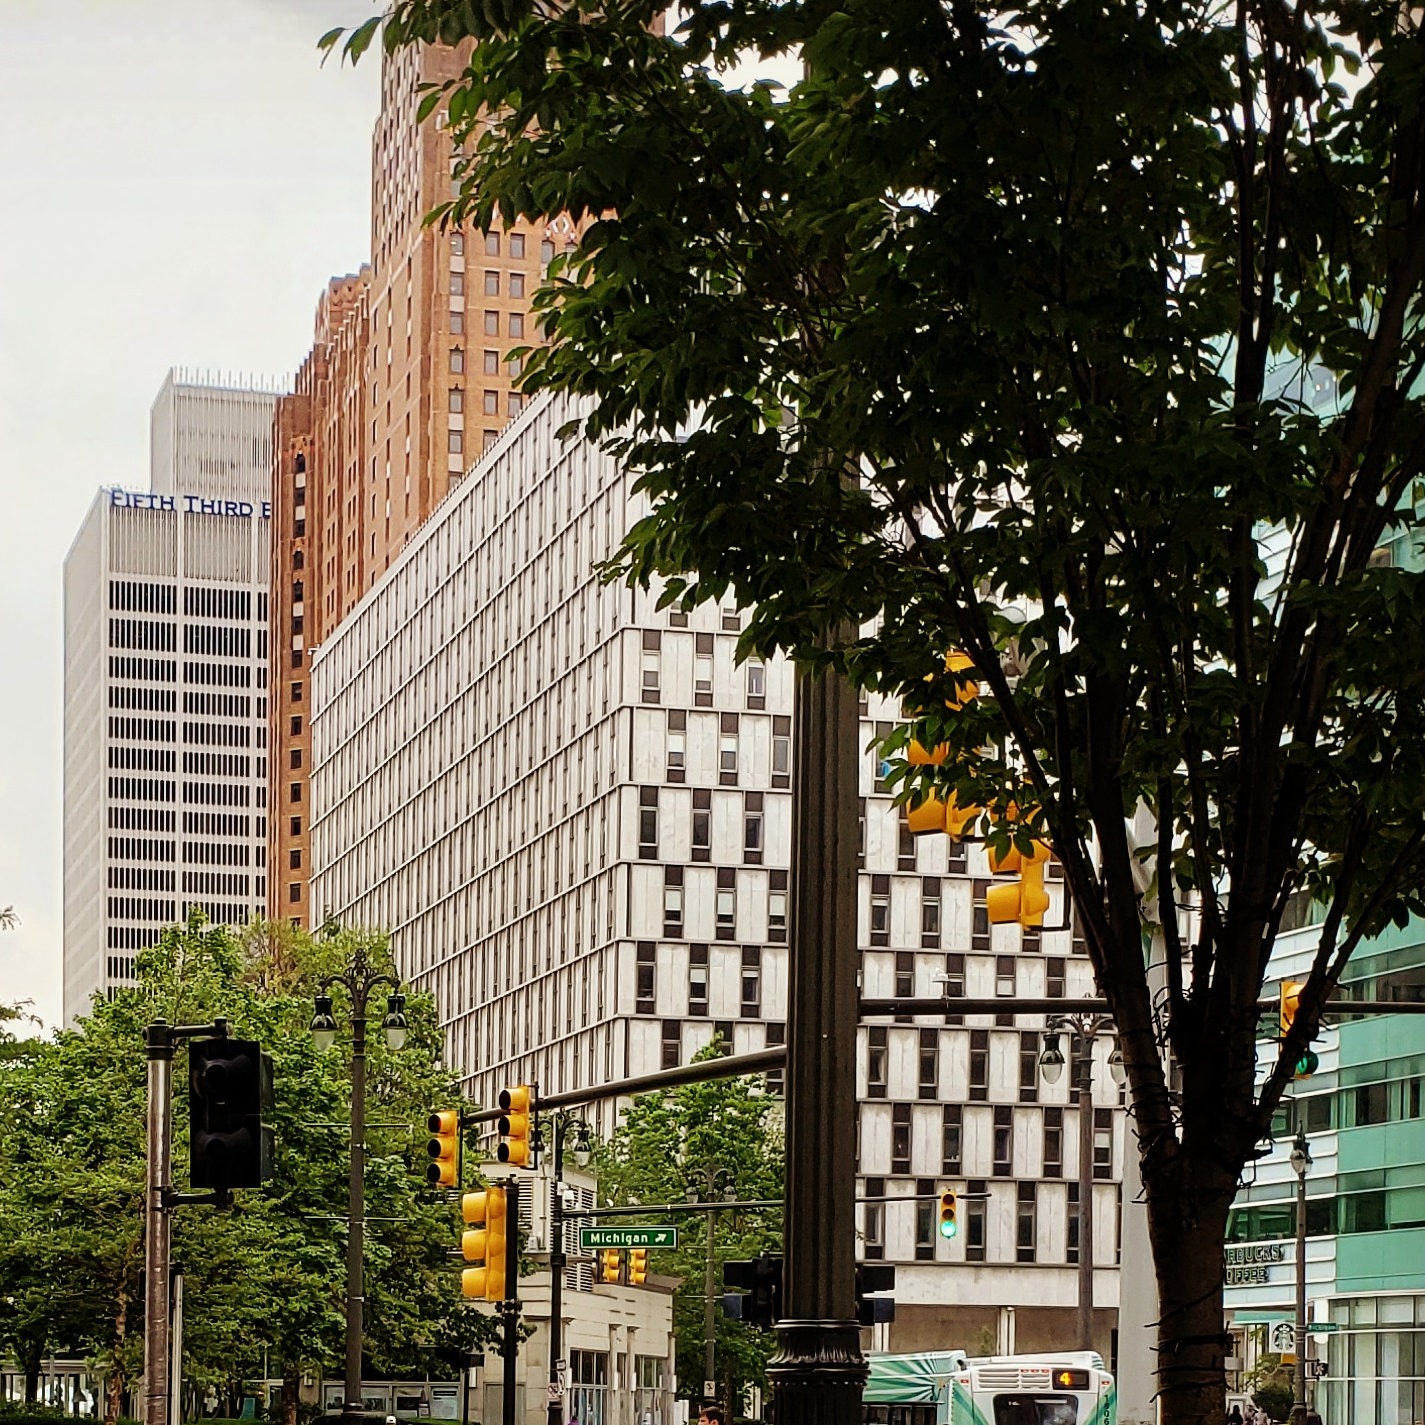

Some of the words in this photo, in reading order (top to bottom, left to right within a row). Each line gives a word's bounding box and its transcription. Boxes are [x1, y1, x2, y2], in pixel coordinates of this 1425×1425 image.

[111, 489, 175, 511] FIFTH
[183, 495, 253, 517] THIRD
[590, 1232, 649, 1246] Michigan
[1059, 1372, 1071, 1386] 4
